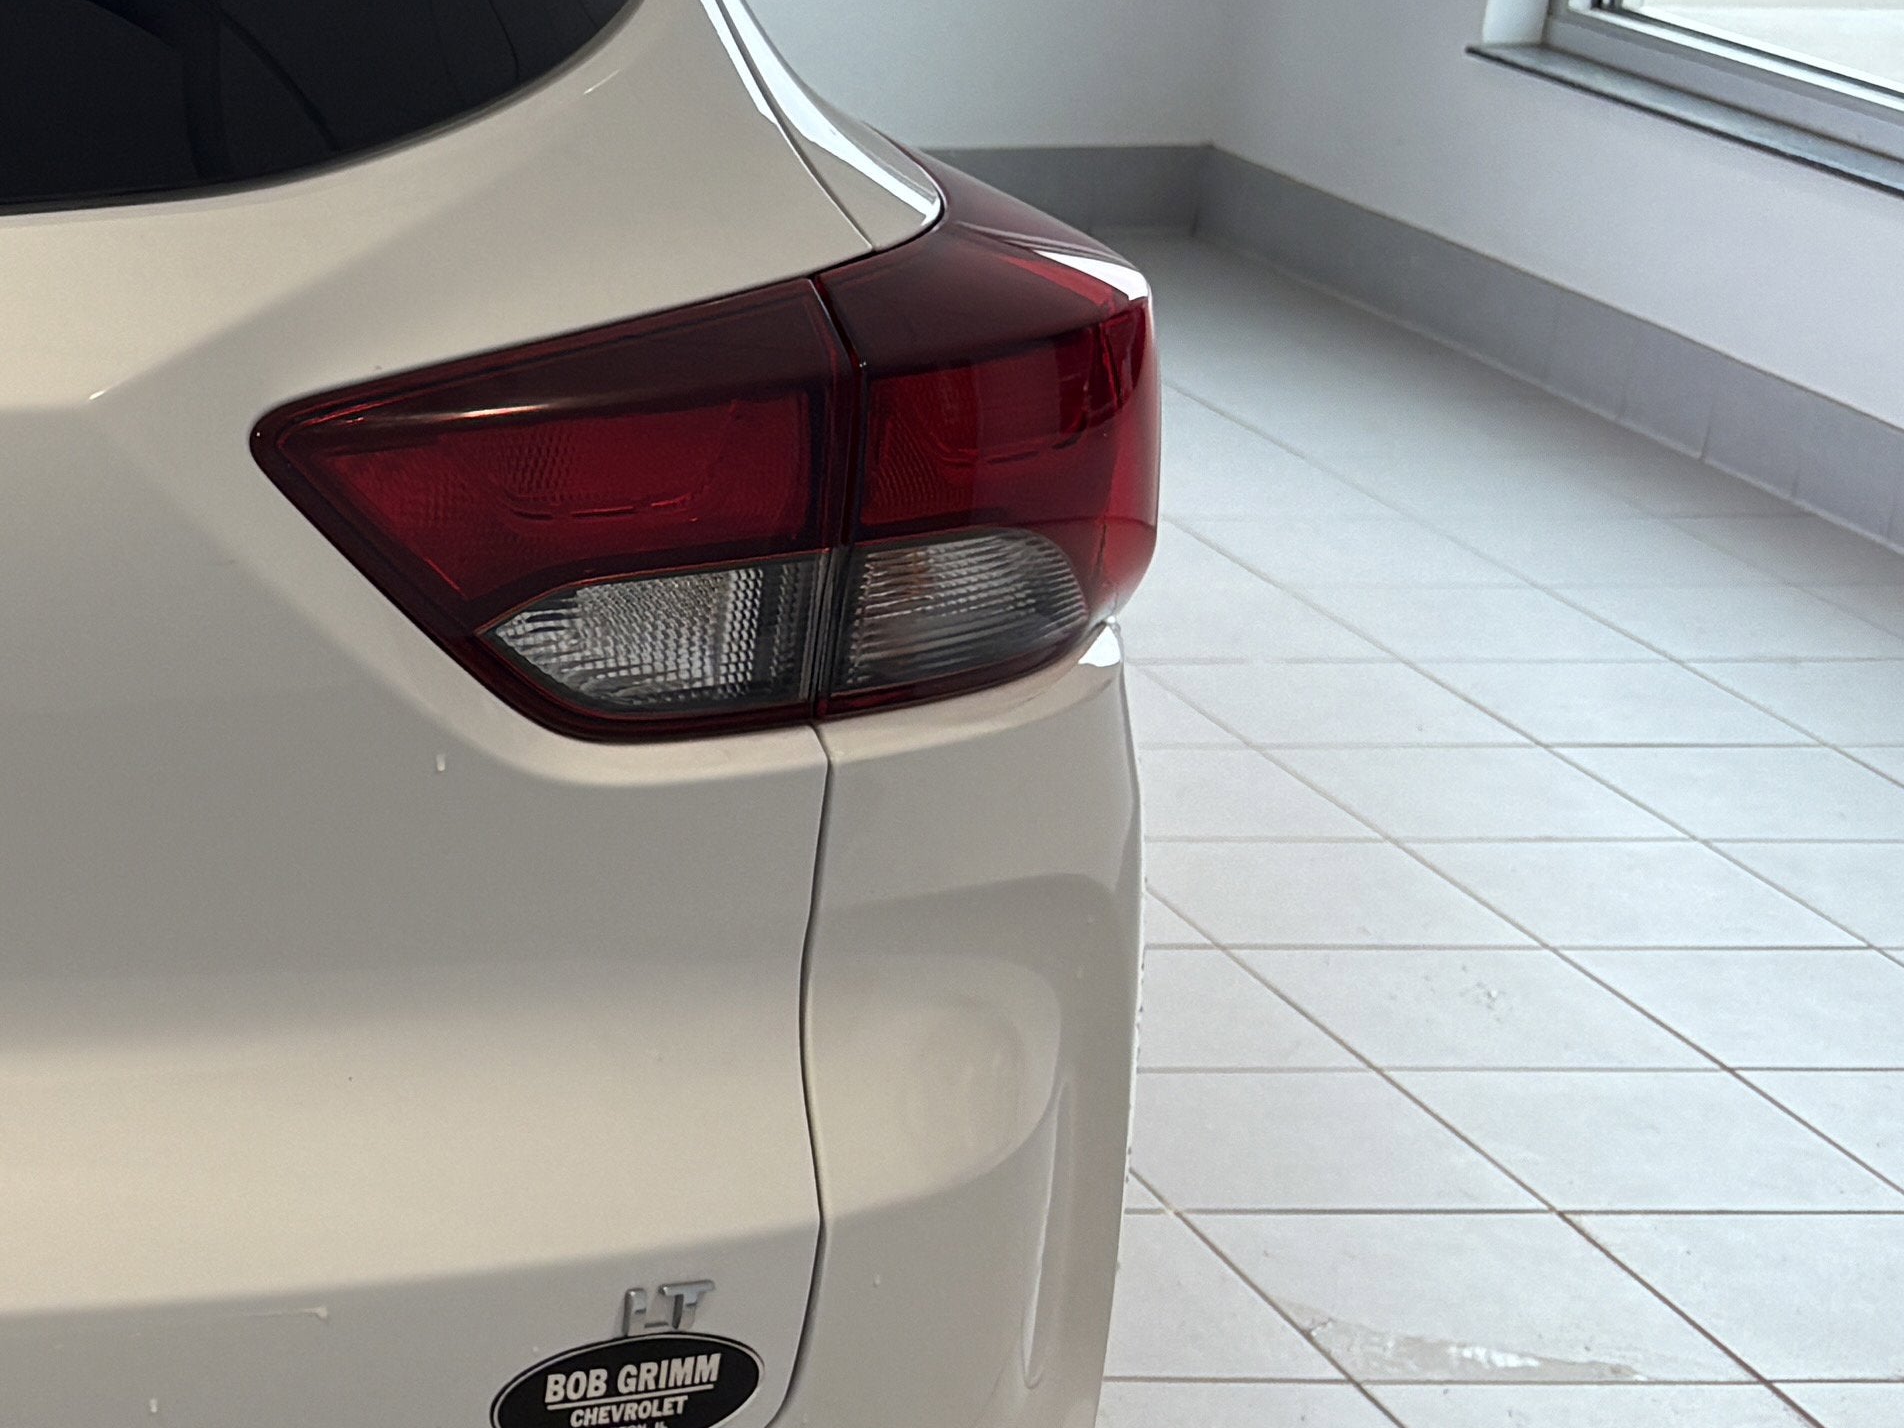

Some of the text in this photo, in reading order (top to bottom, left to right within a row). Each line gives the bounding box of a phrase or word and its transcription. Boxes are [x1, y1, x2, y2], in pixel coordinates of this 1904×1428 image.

[621, 1279, 716, 1338] LT
[544, 1353, 721, 1403] BOB GRIMM
[570, 1395, 689, 1428] CHEVROLET
